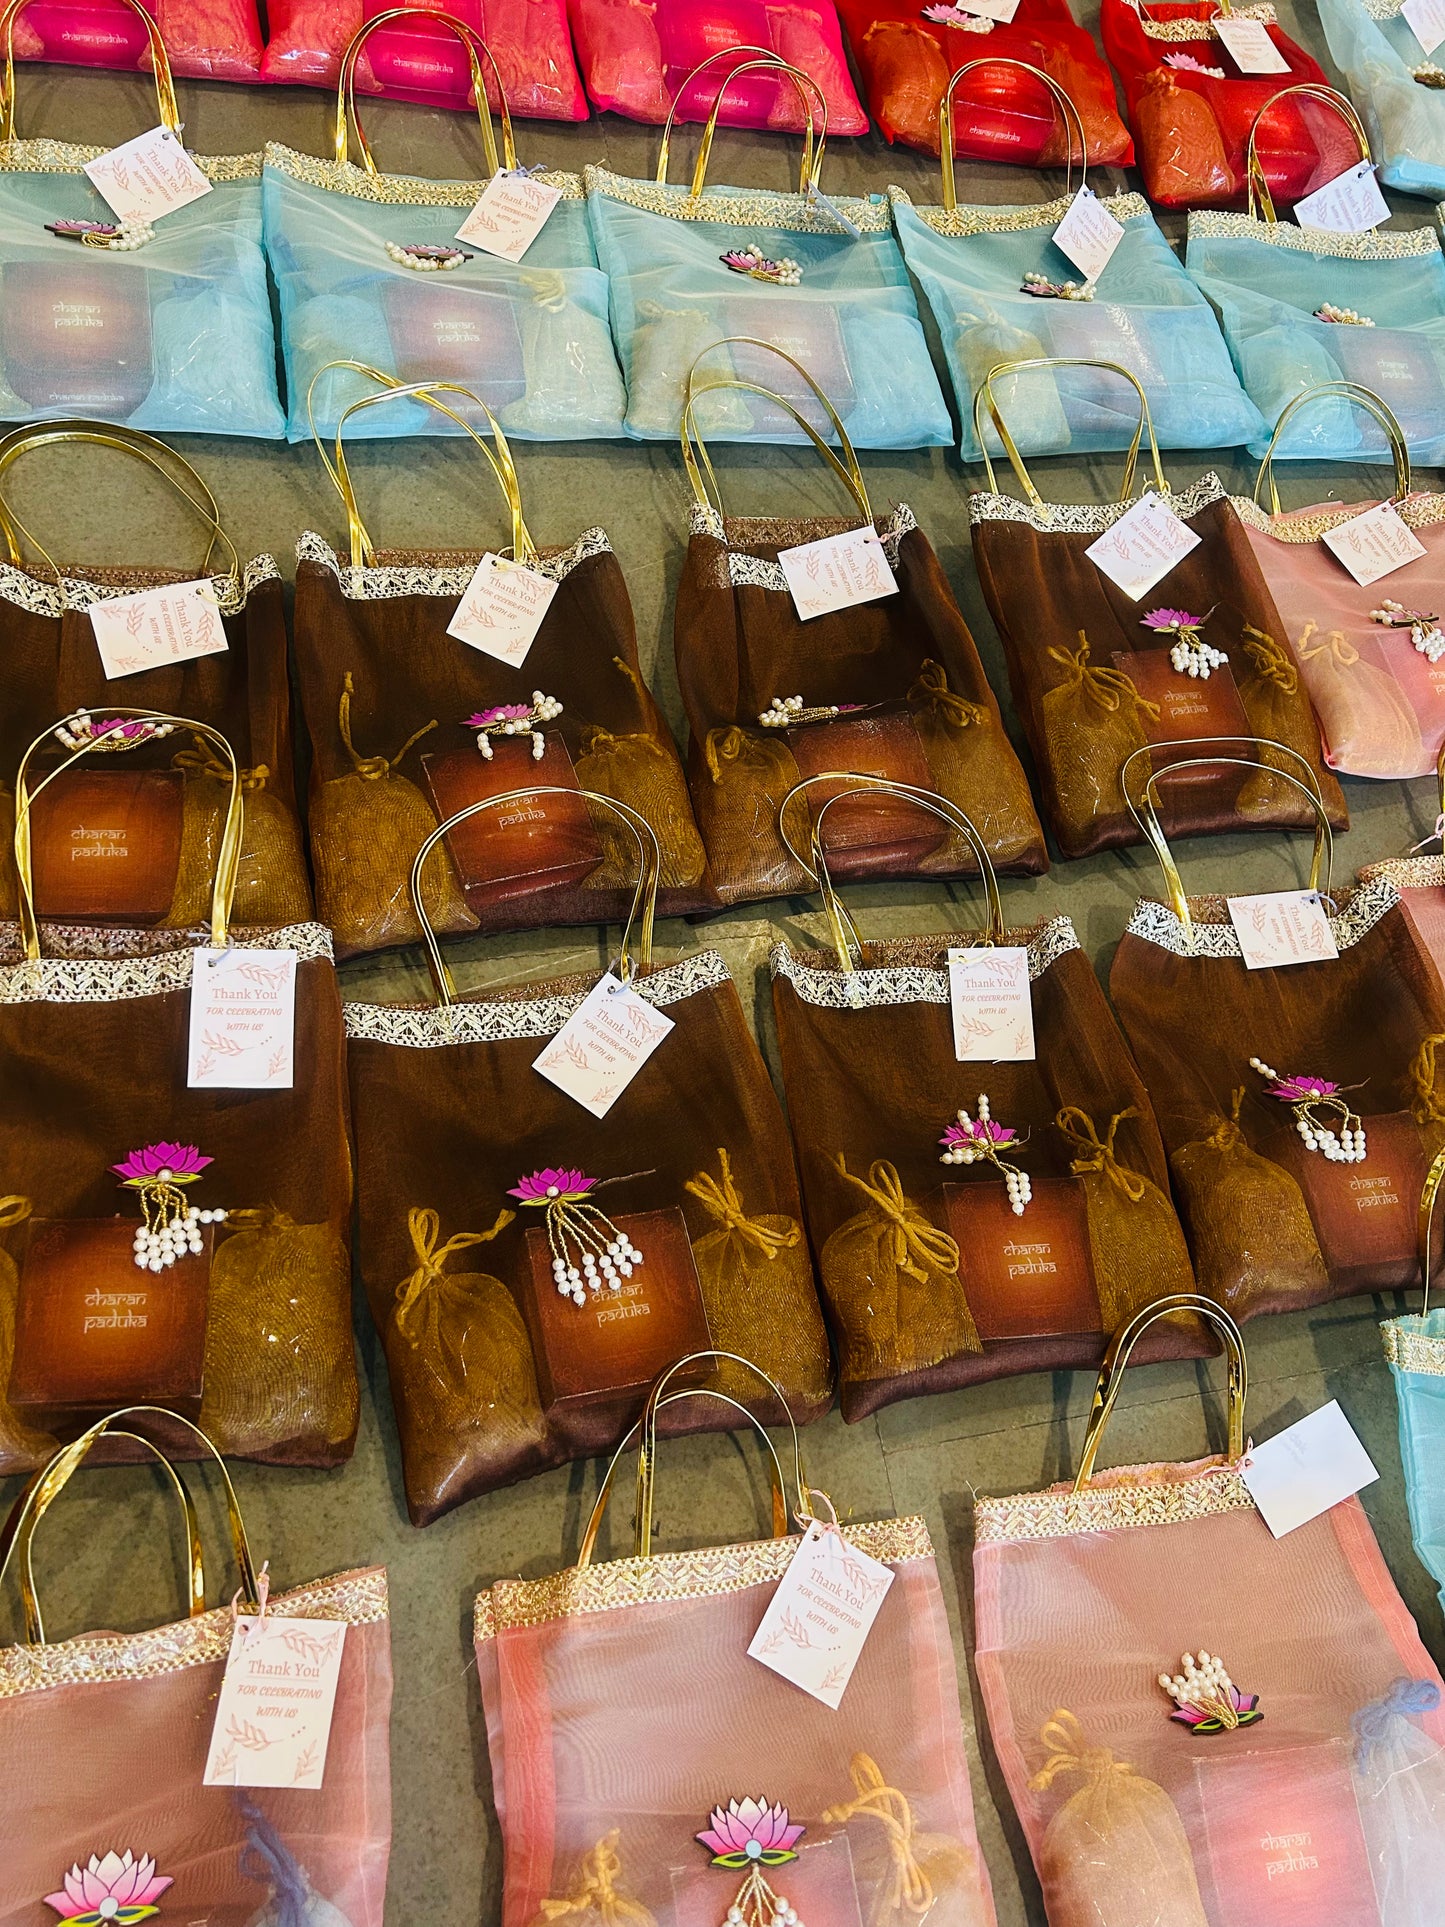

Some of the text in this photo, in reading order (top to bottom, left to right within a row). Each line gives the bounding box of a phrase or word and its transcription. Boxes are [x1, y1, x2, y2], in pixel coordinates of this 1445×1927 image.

[62, 31, 128, 45] charan paduka
[393, 57, 454, 74] charan paduka
[694, 92, 716, 103] chara
[147, 149, 182, 194] Thank You
[499, 191, 539, 212] Thank You
[52, 301, 101, 314] charan
[55, 315, 104, 329] paduka
[433, 319, 476, 330] charan
[436, 332, 480, 346] paduka
[1141, 514, 1175, 551] Thank You
[1374, 520, 1402, 557] Thank You
[844, 547, 865, 591] Thank You
[489, 576, 537, 605] Thank You
[480, 586, 536, 617] FOR CELEBRATING
[175, 598, 194, 648] Thank You
[1164, 690, 1202, 703] charan
[1169, 701, 1208, 719] paduka
[498, 807, 546, 830] paduka
[71, 824, 127, 840] charan
[71, 842, 129, 861] paduka
[1290, 904, 1310, 951] Thank You
[964, 977, 1016, 989] Thank You
[212, 987, 278, 1000] Thank You
[976, 994, 1021, 1002] CELEBRATING
[206, 1007, 283, 1016] FOR CELEBRATING
[226, 1022, 265, 1031] WITH US
[596, 1008, 643, 1049] Thank You
[582, 1019, 638, 1062] FOR CELEBRATING
[587, 1040, 617, 1064] WITH US
[1349, 1175, 1392, 1191] charan
[1356, 1190, 1399, 1212] paduka
[1003, 1240, 1051, 1256] charan
[1008, 1257, 1057, 1280] paduka
[84, 1287, 148, 1306] charan
[591, 1284, 644, 1303] charan
[84, 1309, 148, 1334] paduka
[596, 1300, 651, 1327] paduka
[810, 1567, 865, 1611] Thank You
[796, 1584, 862, 1630] FOR CELEBRATING
[806, 1610, 839, 1635] WITH US
[248, 1659, 320, 1678] Thank You
[237, 1684, 323, 1700] FOR CELEBRATING
[256, 1706, 299, 1719] WITH US
[1259, 1831, 1313, 1851] charan
[1265, 1851, 1319, 1881] paduka
